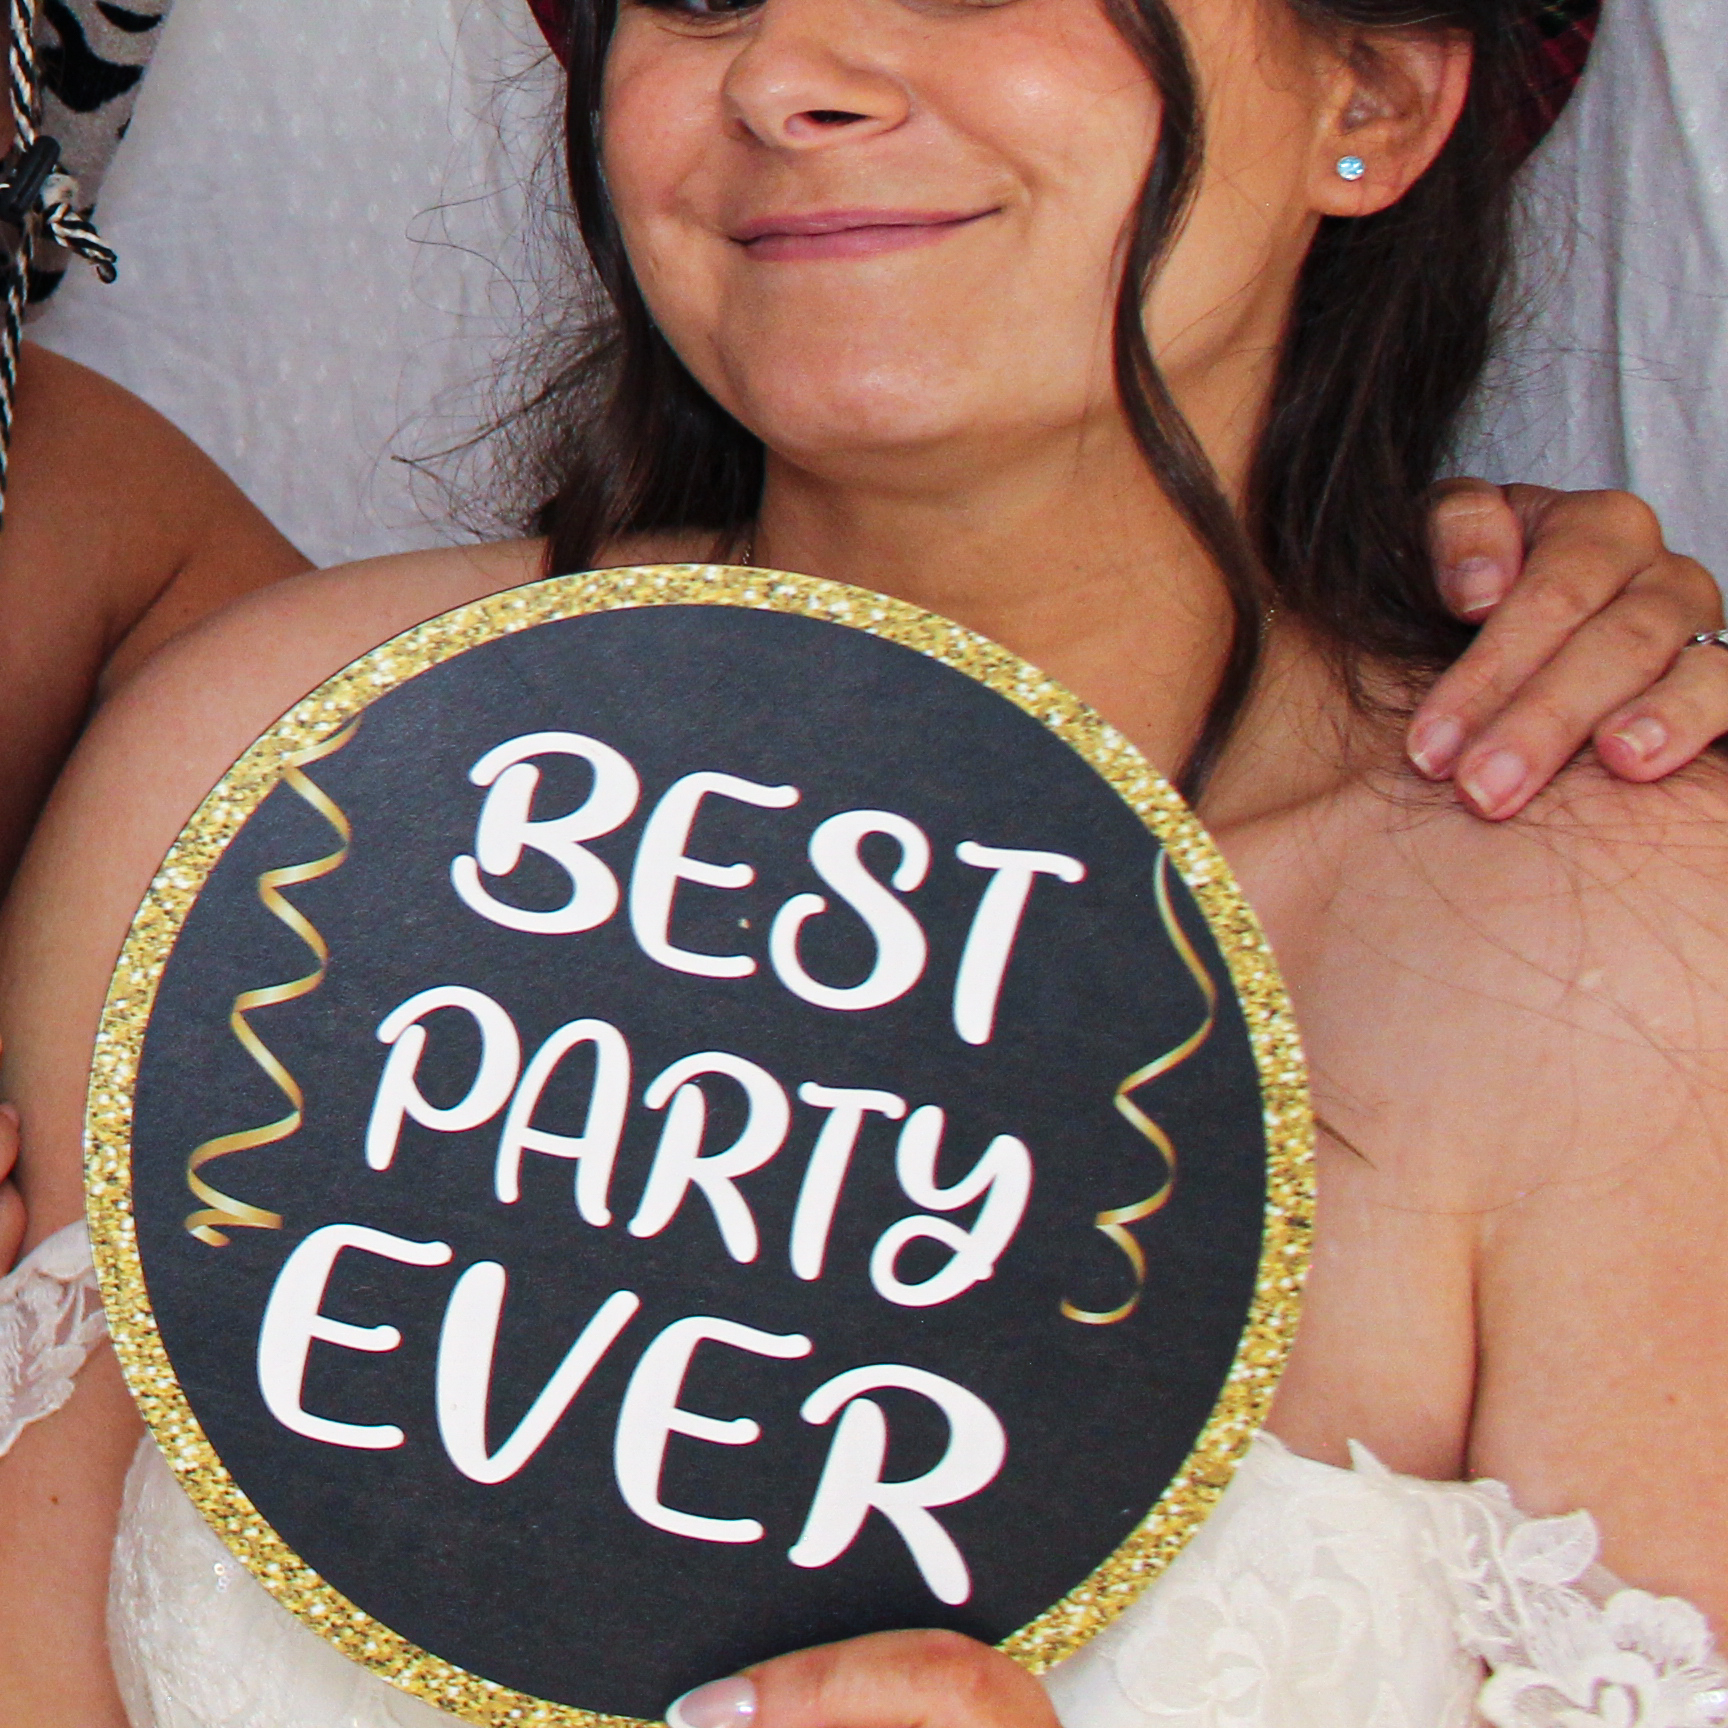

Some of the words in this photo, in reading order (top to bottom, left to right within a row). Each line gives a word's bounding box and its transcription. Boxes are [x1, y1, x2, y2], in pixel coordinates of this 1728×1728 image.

[449, 730, 1086, 1046] BEST
[364, 984, 1033, 1308] PARTY
[256, 1222, 1007, 1606] EVER
